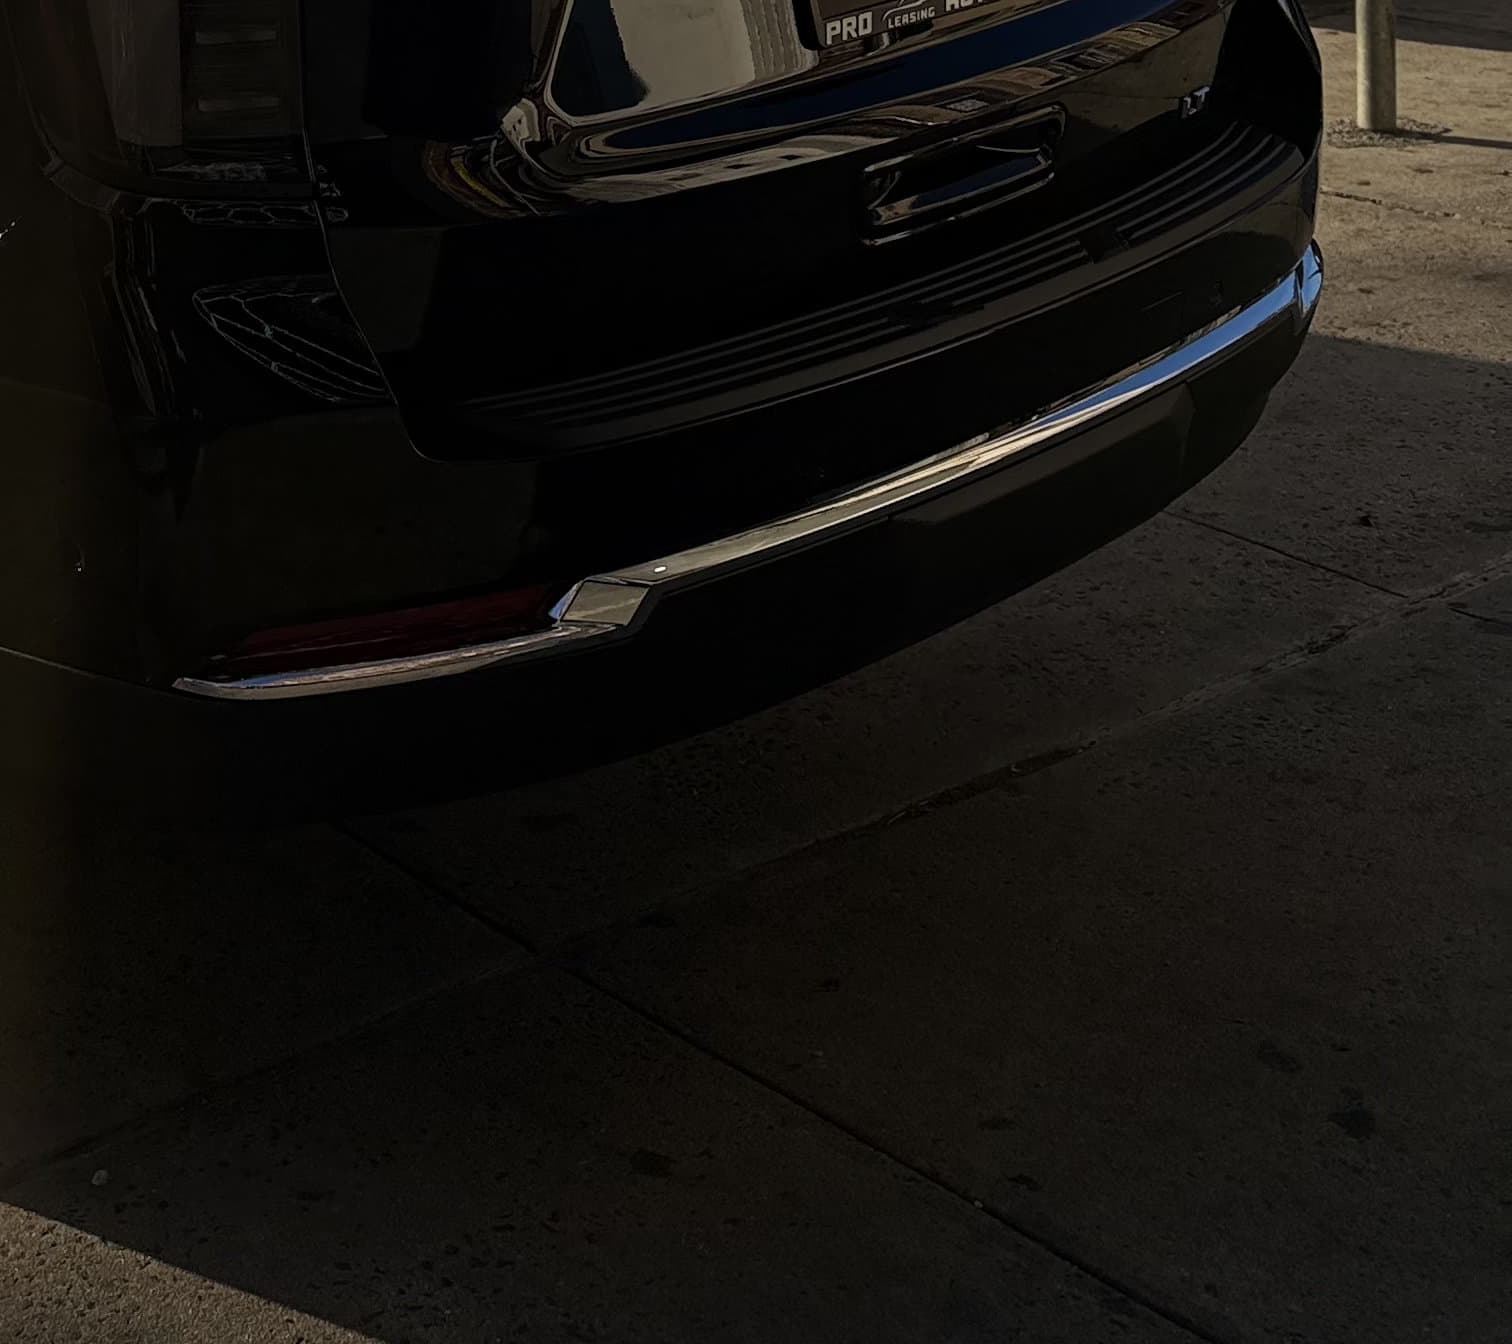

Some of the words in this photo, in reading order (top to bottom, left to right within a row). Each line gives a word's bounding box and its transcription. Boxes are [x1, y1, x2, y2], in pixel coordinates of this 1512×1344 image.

[825, 11, 874, 46] PRO
[887, 6, 936, 29] LEASING
[1181, 86, 1210, 119] LT
